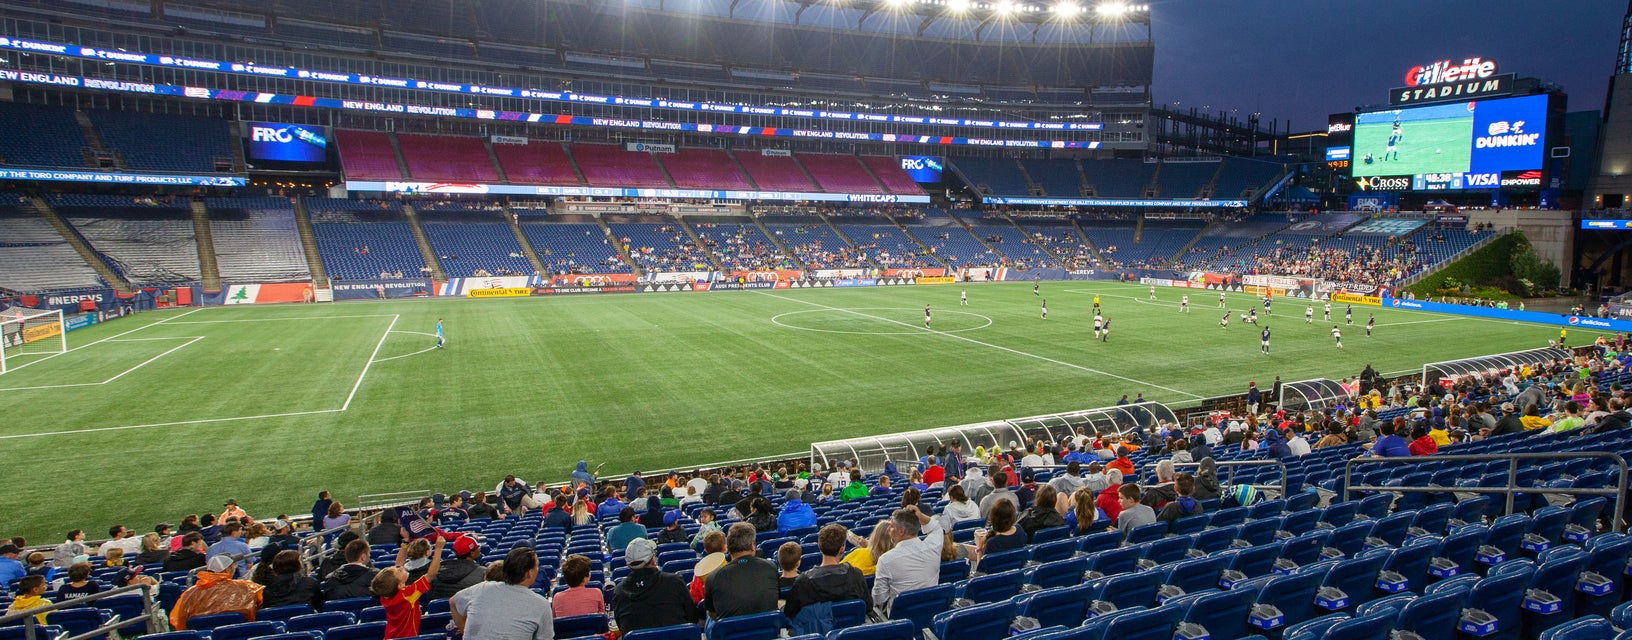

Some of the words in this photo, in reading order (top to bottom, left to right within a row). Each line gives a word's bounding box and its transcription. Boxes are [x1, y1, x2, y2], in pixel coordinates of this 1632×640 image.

[1406, 57, 1496, 86] Gillette
[20, 72, 78, 86] ENGLAND
[84, 78, 154, 92] REVOLUTION
[1400, 80, 1500, 101] STADIUM
[343, 101, 363, 109] NEW
[364, 102, 403, 112] ENGLAND
[407, 106, 456, 116] REVOLUTION
[1328, 124, 1351, 134] jetBlue
[1476, 133, 1540, 149] DUNKIN'
[1370, 177, 1408, 187] CROSS
[1467, 173, 1498, 186] VISA
[470, 288, 507, 297] Continental
[1332, 294, 1363, 302] Continental
